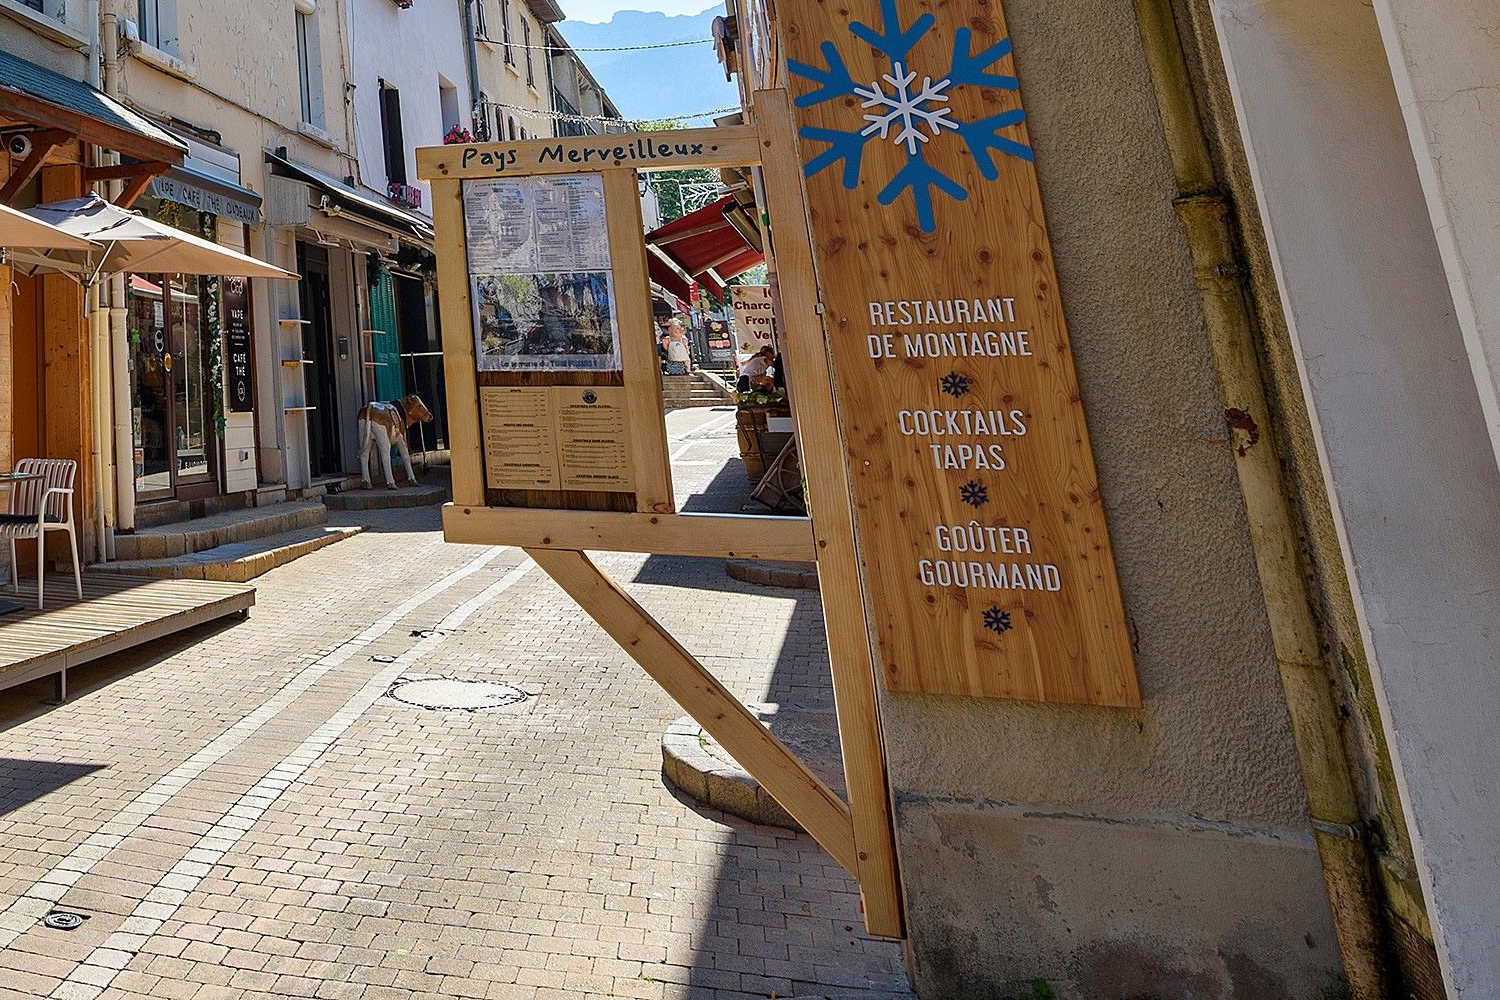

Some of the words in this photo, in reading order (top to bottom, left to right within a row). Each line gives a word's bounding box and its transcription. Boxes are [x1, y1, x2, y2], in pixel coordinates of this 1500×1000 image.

[462, 148, 517, 172] Pays
[538, 138, 703, 164] Merveilleux
[869, 298, 1016, 326] RESTAURANT
[867, 333, 896, 359] DE
[904, 331, 1032, 358] MONTAGNE
[899, 410, 1028, 436] COCKTAILS
[930, 444, 1006, 471] TAPAS
[934, 520, 1032, 555] GOÛTER
[918, 560, 1062, 592] GOURMAND
